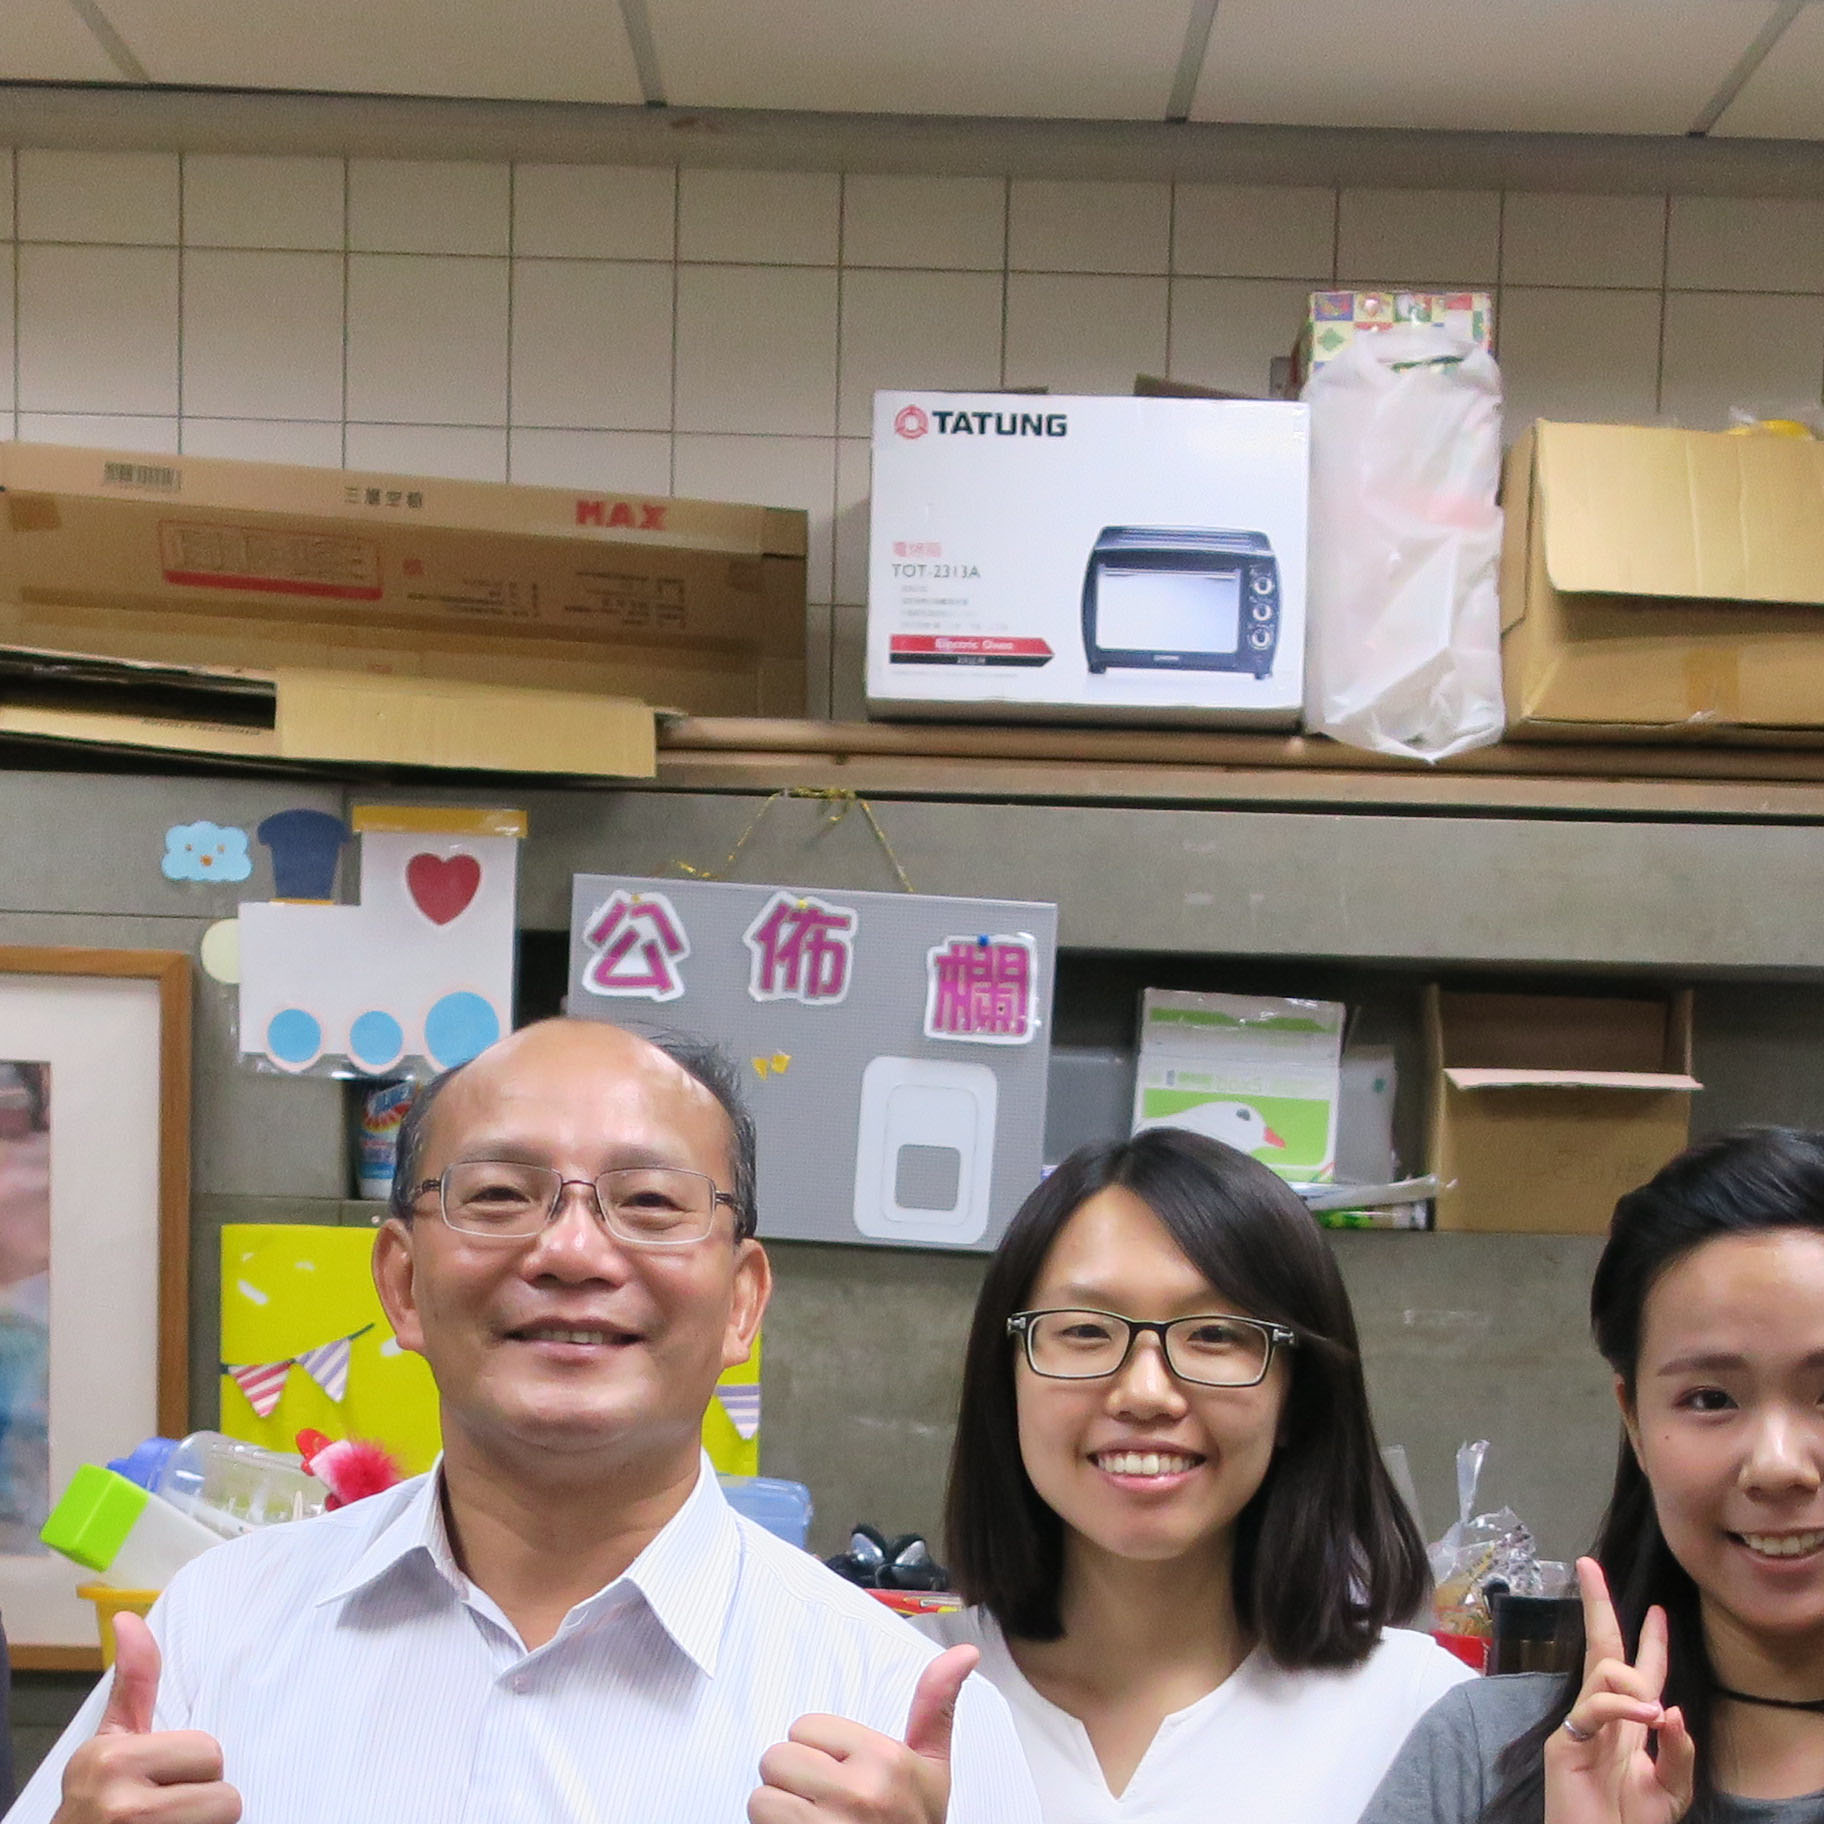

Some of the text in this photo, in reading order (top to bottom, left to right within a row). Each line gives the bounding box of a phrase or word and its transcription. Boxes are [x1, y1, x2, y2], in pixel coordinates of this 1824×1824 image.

[932, 411, 1067, 437] TATUNG
[575, 499, 667, 531] MAX
[891, 563, 981, 580] TOT-2313A
[590, 901, 1030, 1036] 公佈欄
